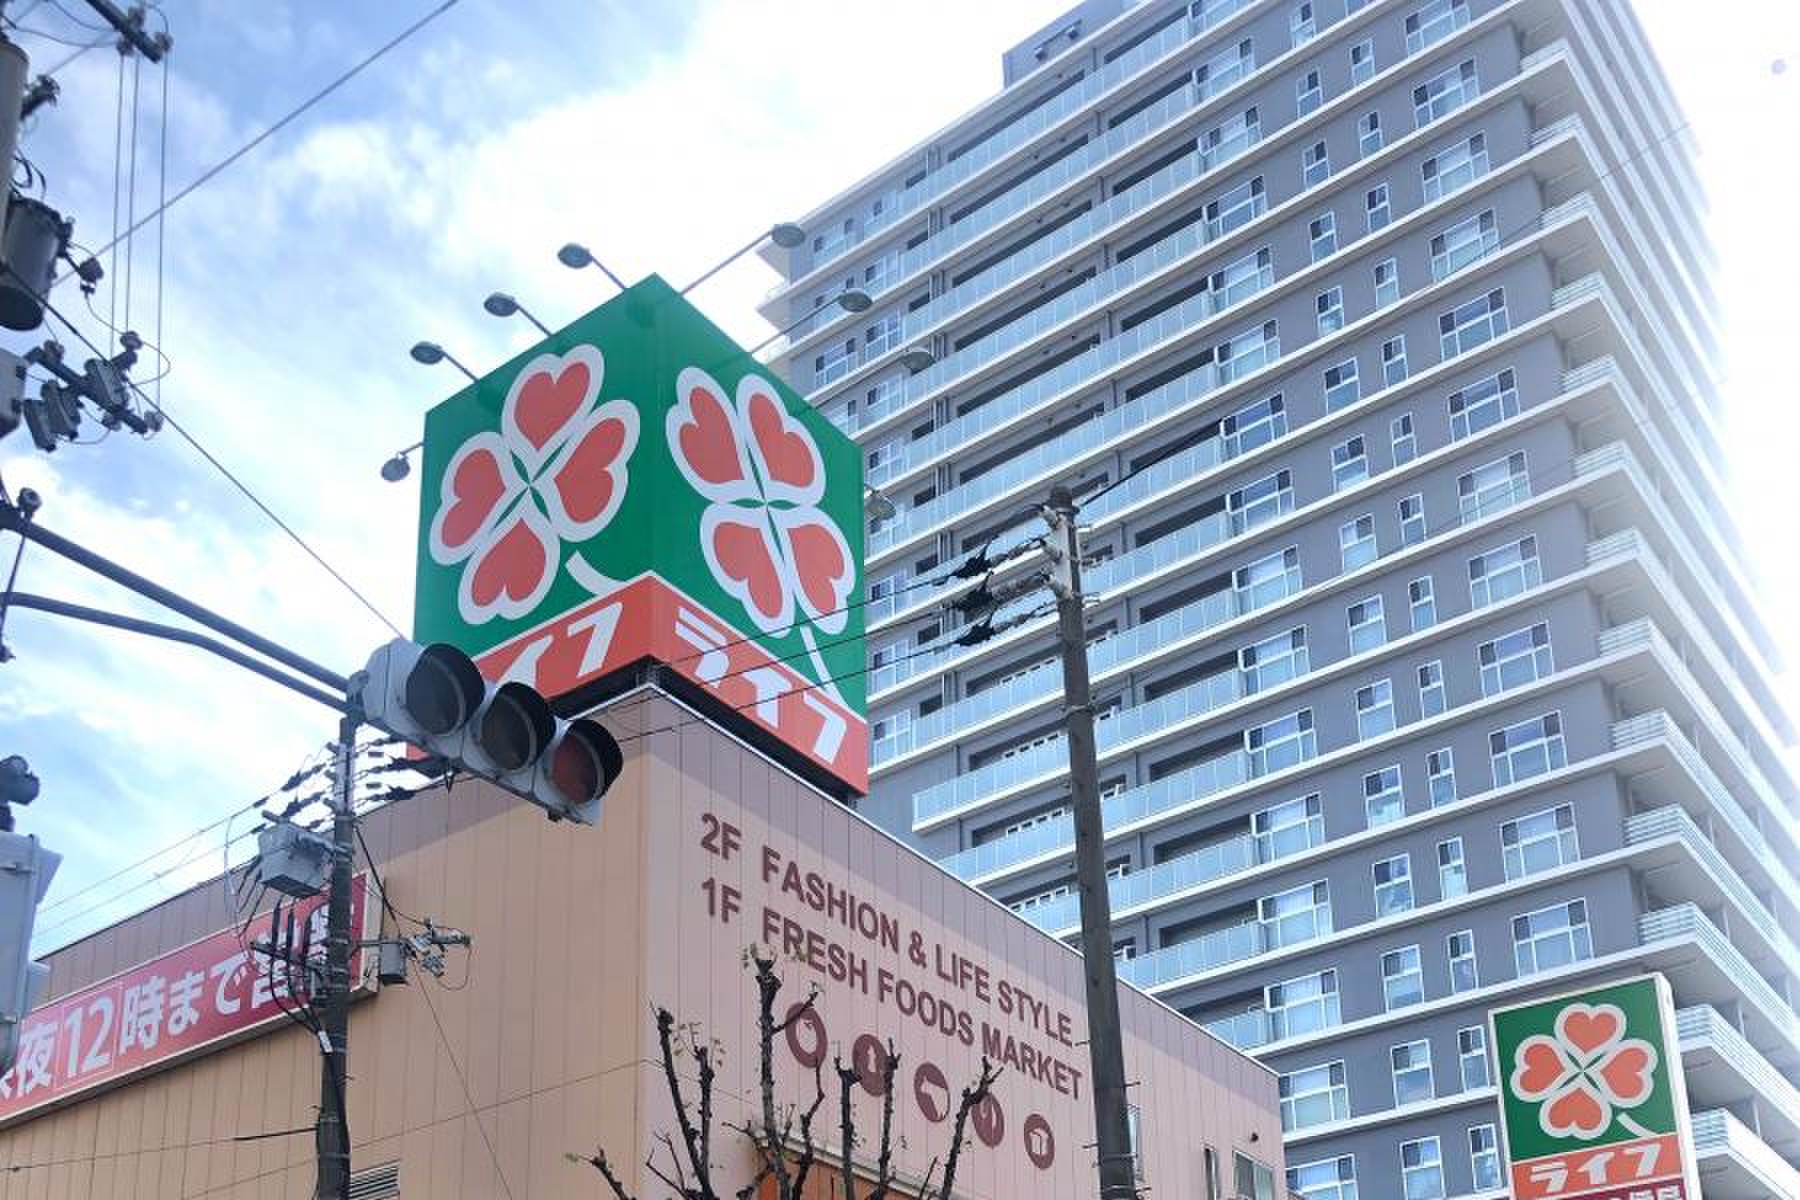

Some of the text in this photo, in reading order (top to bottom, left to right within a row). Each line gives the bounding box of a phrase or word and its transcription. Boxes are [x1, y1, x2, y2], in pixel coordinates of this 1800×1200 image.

[497, 601, 623, 687] イフ
[675, 606, 847, 764] ライフ
[701, 812, 1074, 1048] 2F FASHION & LIFE STYLE
[701, 876, 1082, 1101] 1F FRESH FOODS MARKET
[1529, 1144, 1662, 1193] ライフ
